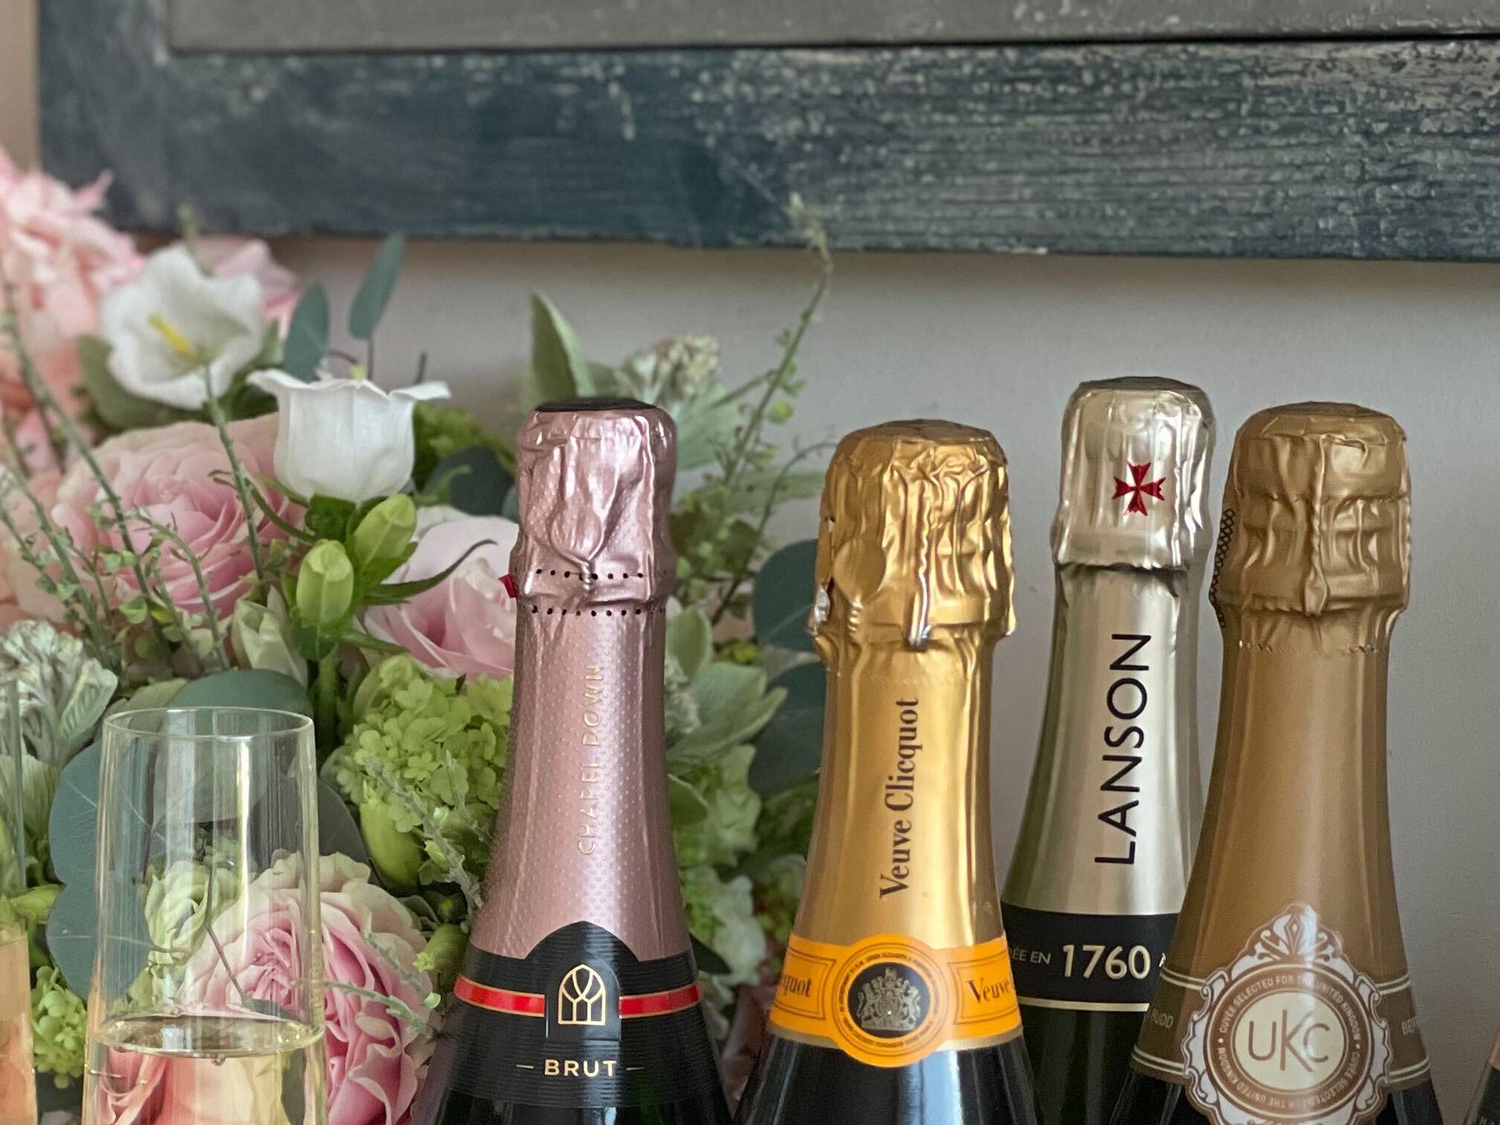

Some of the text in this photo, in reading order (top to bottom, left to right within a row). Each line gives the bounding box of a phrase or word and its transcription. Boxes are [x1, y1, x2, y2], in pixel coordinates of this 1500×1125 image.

[1094, 634, 1152, 864] LANSON
[879, 696, 923, 899] Veuve Clicquot
[1030, 951, 1050, 965] EN
[1062, 944, 1151, 980] 1760
[544, 1059, 618, 1077] BRUT
[1249, 1009, 1331, 1073] UKC
